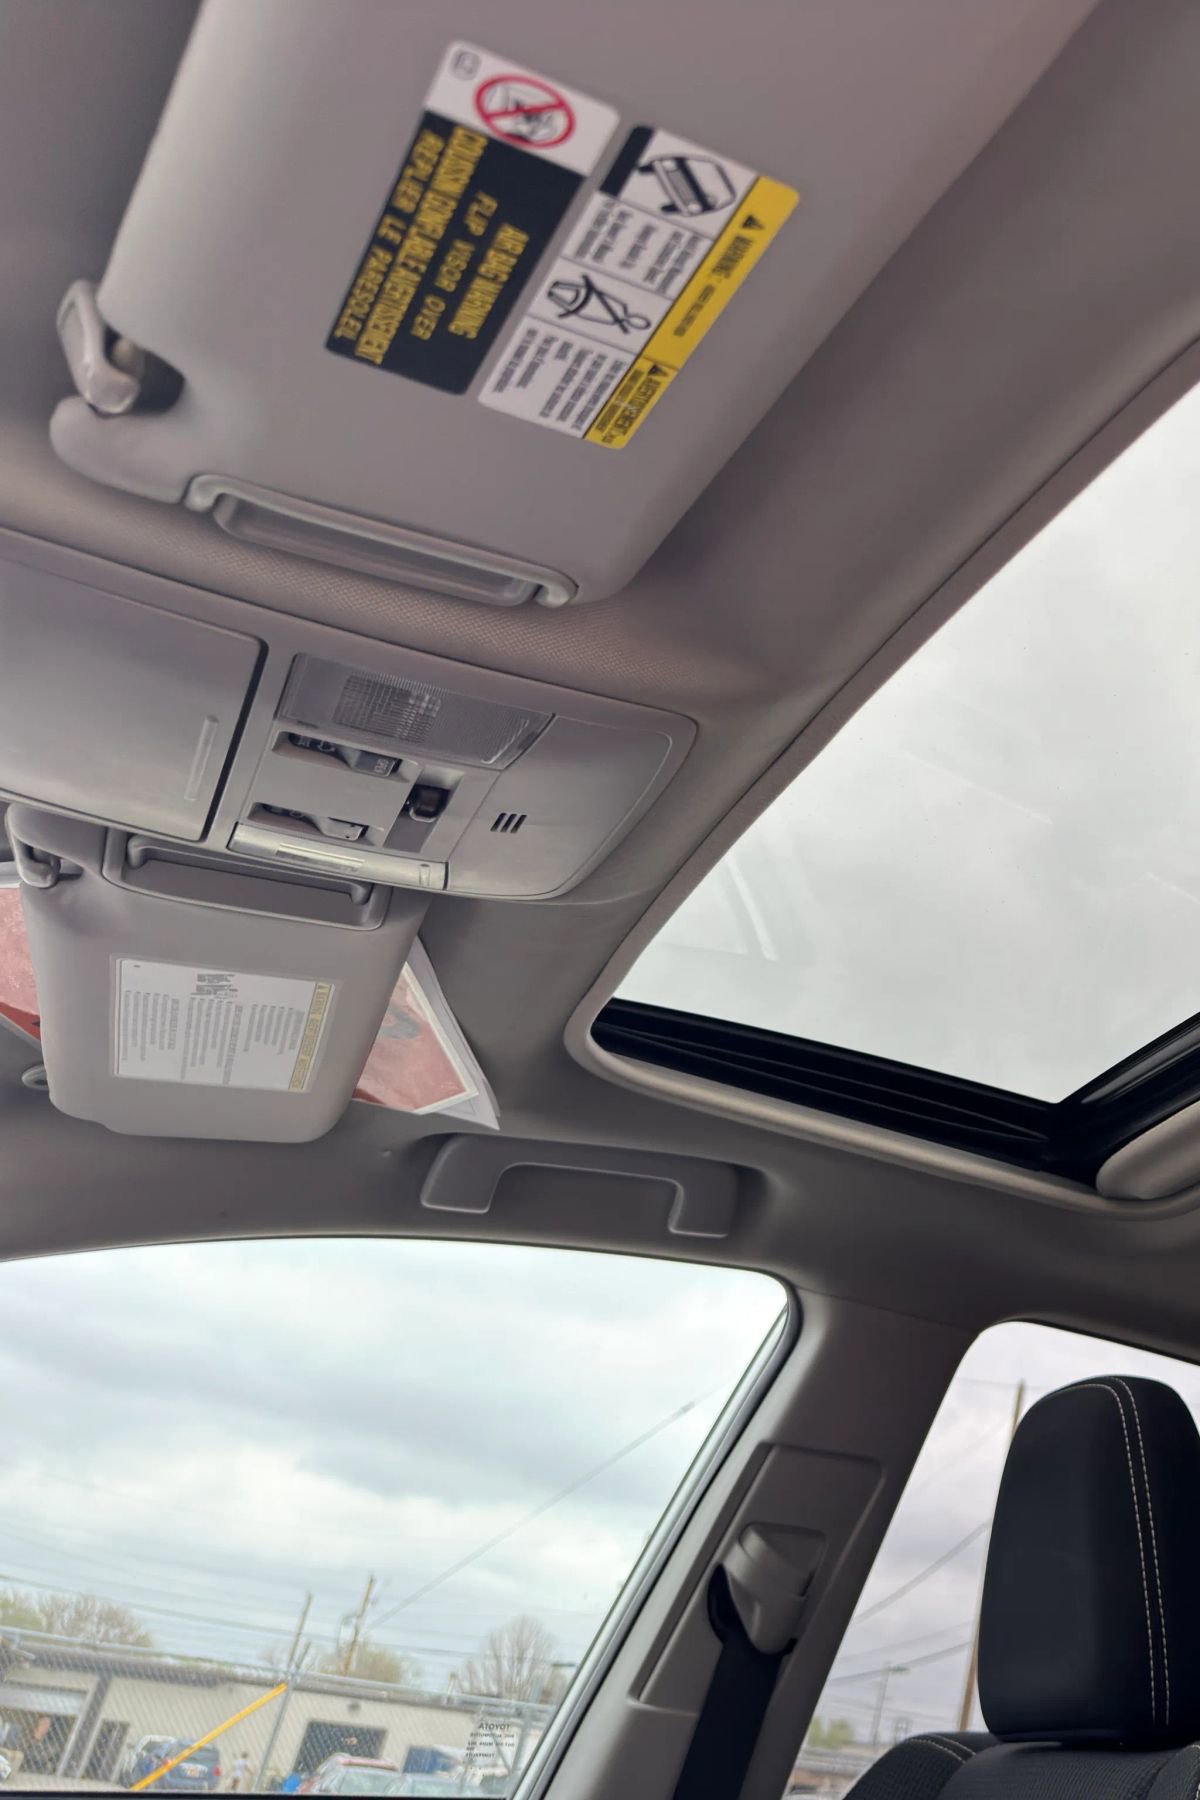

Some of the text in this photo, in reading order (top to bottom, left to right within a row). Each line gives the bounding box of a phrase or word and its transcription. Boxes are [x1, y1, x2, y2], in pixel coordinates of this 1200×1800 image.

[332, 128, 447, 342] REPLIER LE PARESOLEIL
[351, 124, 490, 365] COUSSIN GONFLABLE AVERTISSEMENT
[406, 191, 501, 341] FLIP VISOR OVER
[475, 247, 519, 283] BAG
[489, 222, 532, 256] AIR
[445, 275, 504, 340] WARNING
